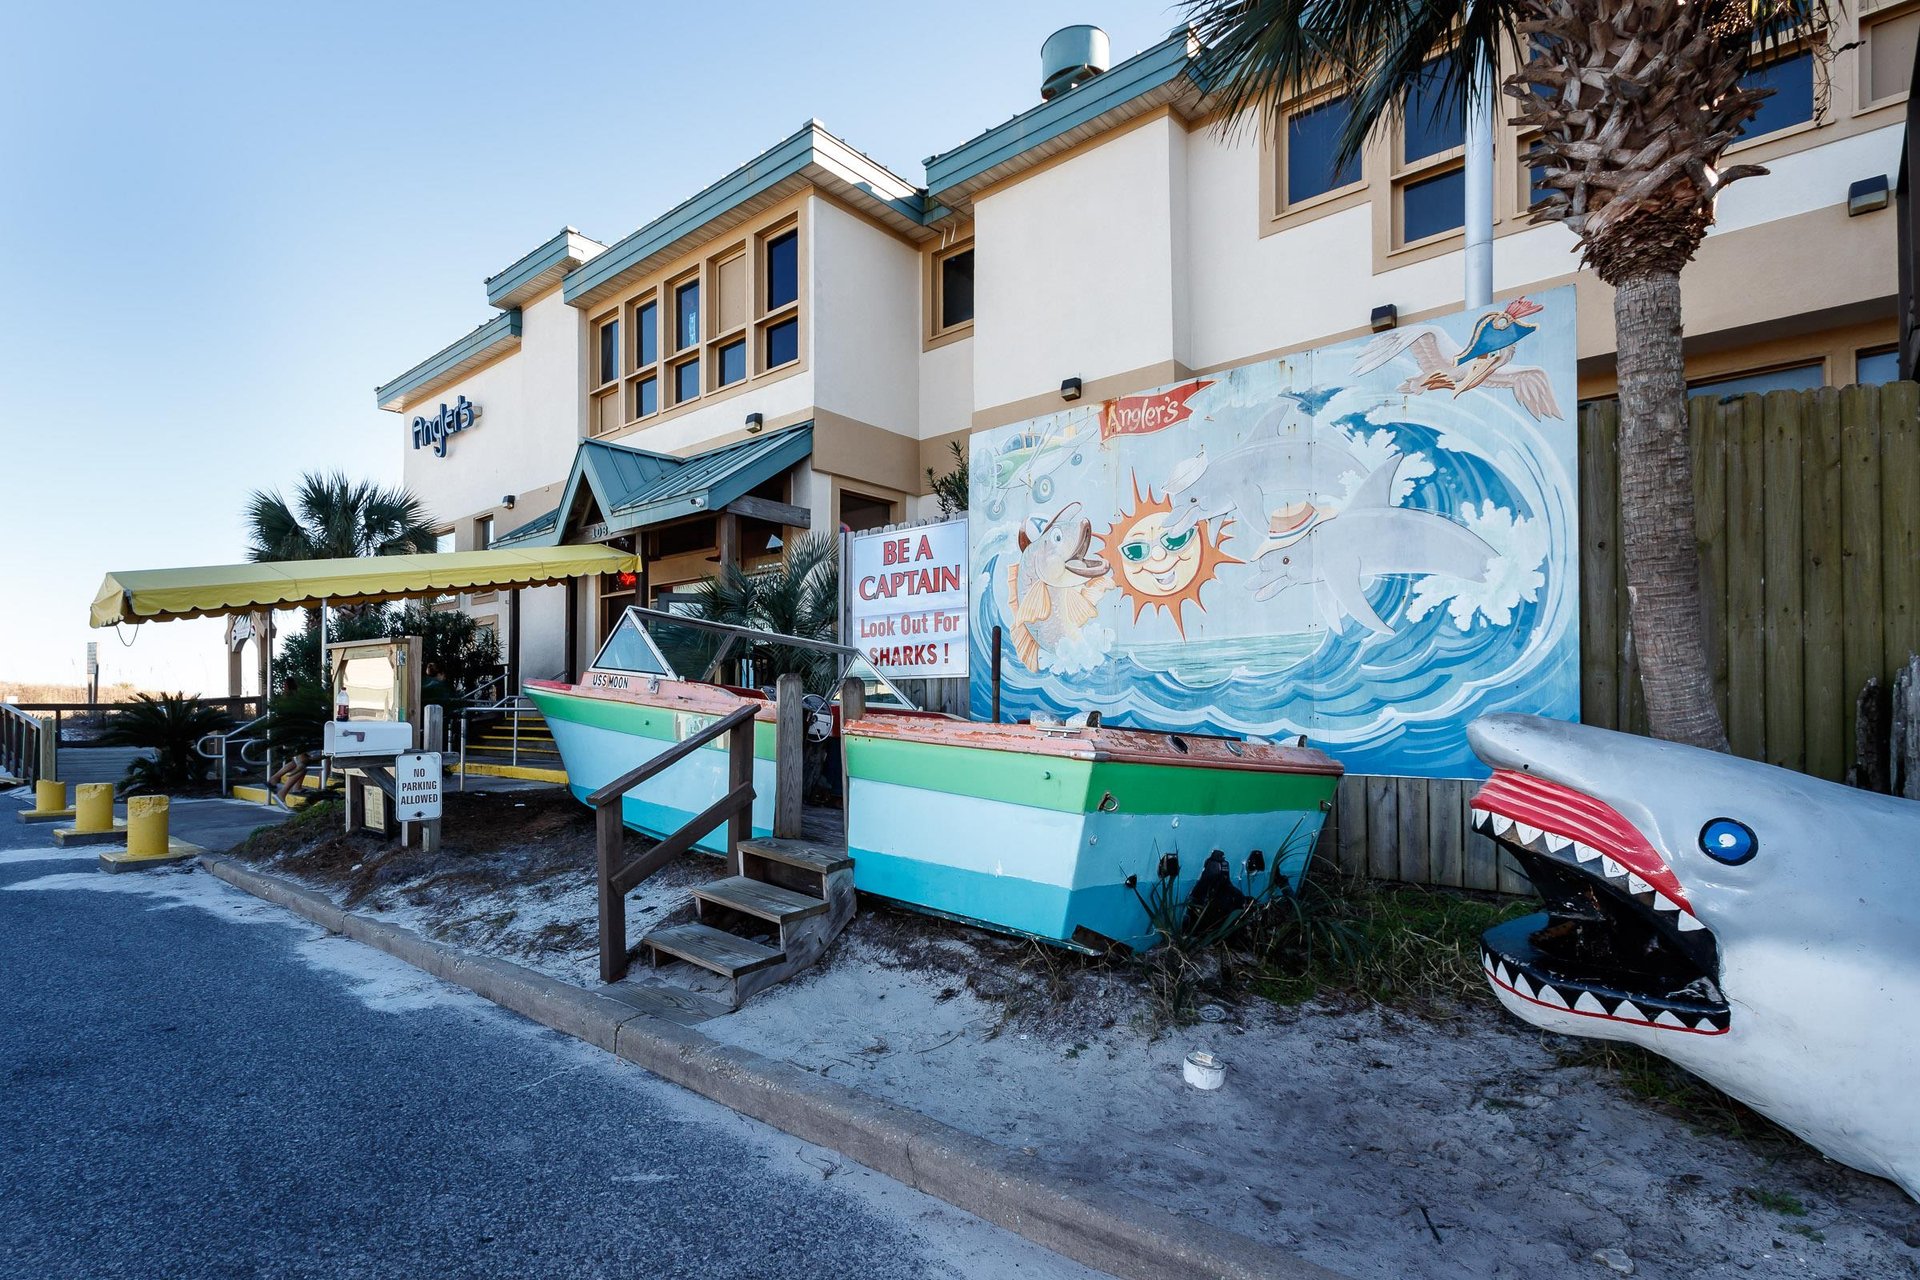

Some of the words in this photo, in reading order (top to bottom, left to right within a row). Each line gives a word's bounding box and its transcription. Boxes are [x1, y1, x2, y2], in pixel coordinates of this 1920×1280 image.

[412, 395, 475, 458] Angler's
[1104, 396, 1179, 437] Angler's
[883, 538, 910, 567] BE
[915, 534, 933, 562] A
[859, 564, 961, 600] CAPTAIN
[861, 616, 895, 638] Look
[901, 613, 928, 635] Out
[934, 611, 960, 632] For
[869, 643, 938, 666] SHARKS
[592, 674, 607, 687] USS
[608, 675, 628, 689] MOON
[413, 768, 426, 778] NO
[401, 781, 437, 791] PARKING
[400, 794, 438, 805] ALLOWED
